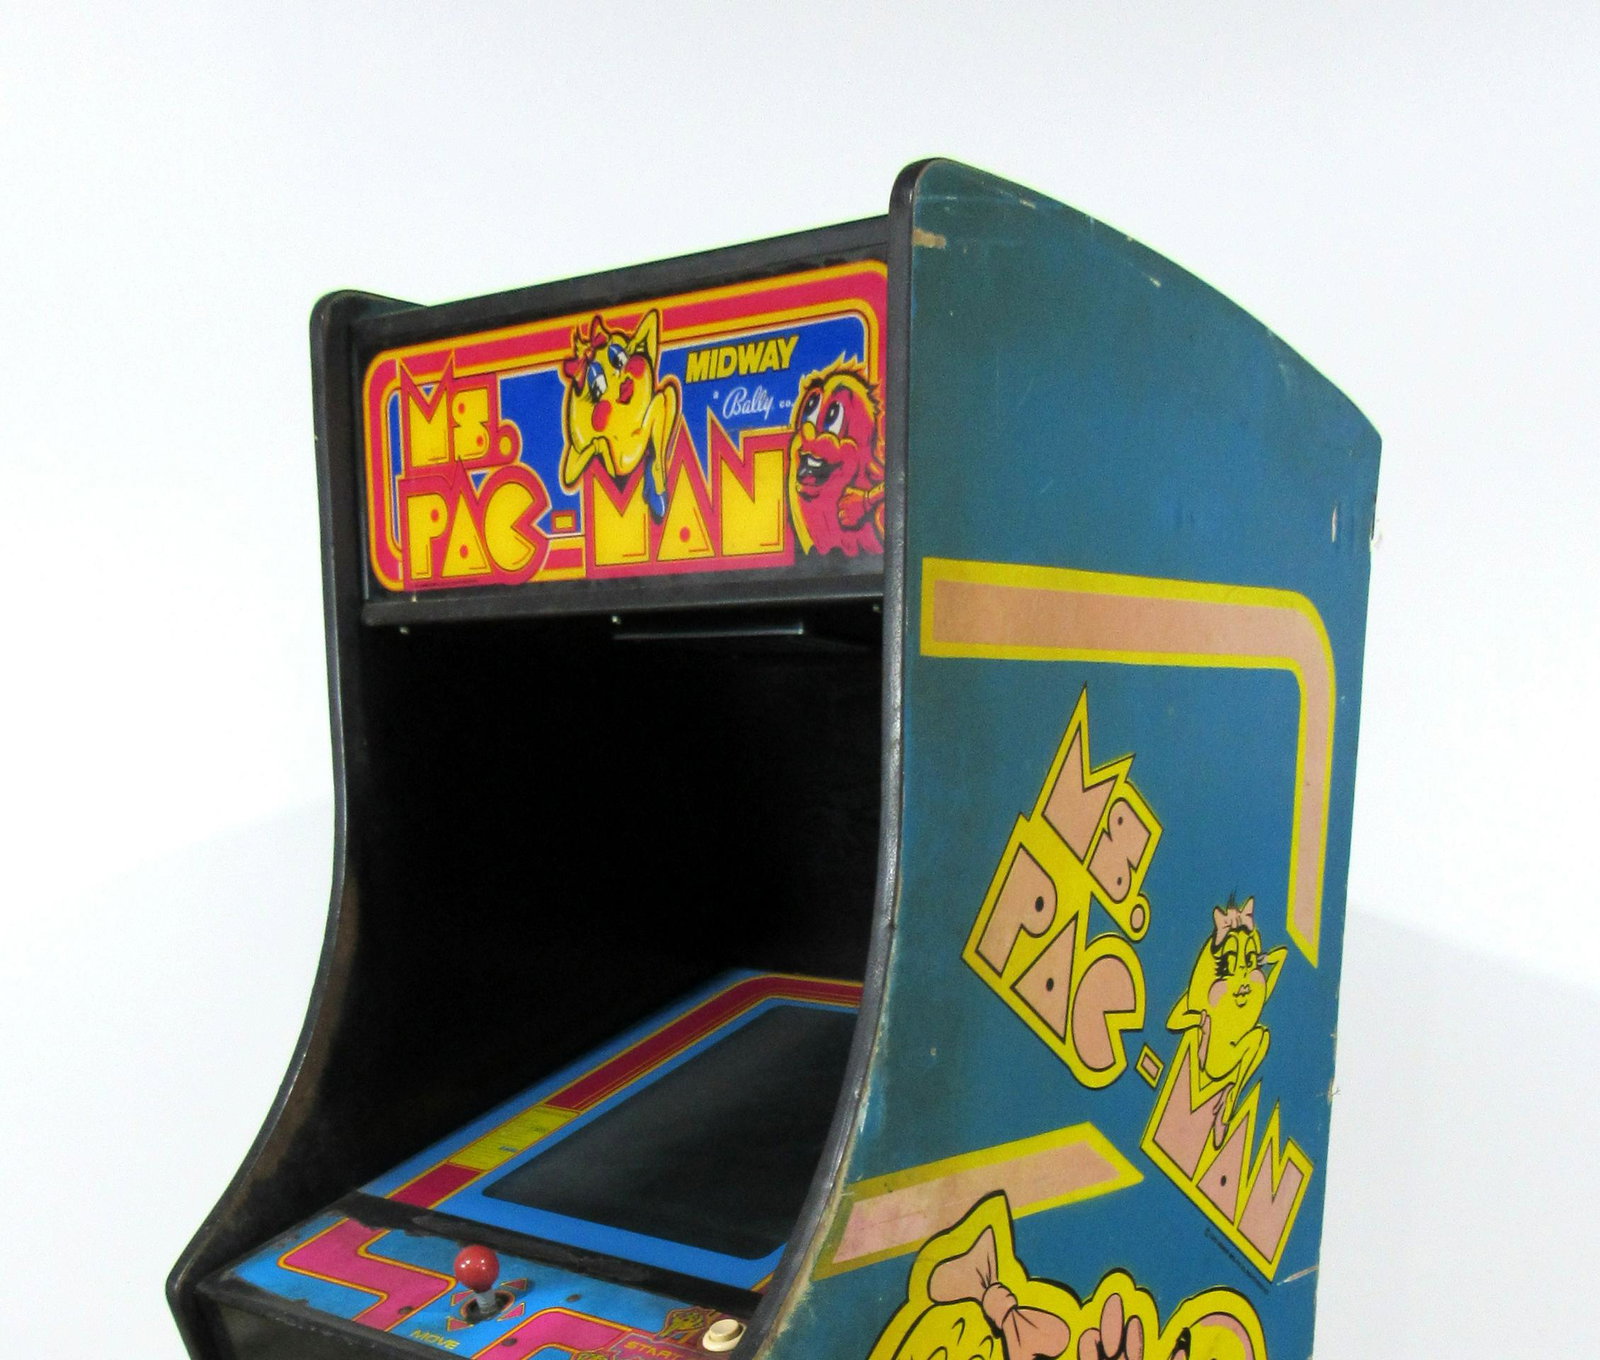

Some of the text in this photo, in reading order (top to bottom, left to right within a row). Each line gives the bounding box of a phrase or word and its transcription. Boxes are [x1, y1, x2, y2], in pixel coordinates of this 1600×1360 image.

[685, 335, 799, 384] MIDWAY
[722, 384, 774, 421] Bally
[411, 1329, 460, 1350] MOVE
[623, 1341, 684, 1360] START
